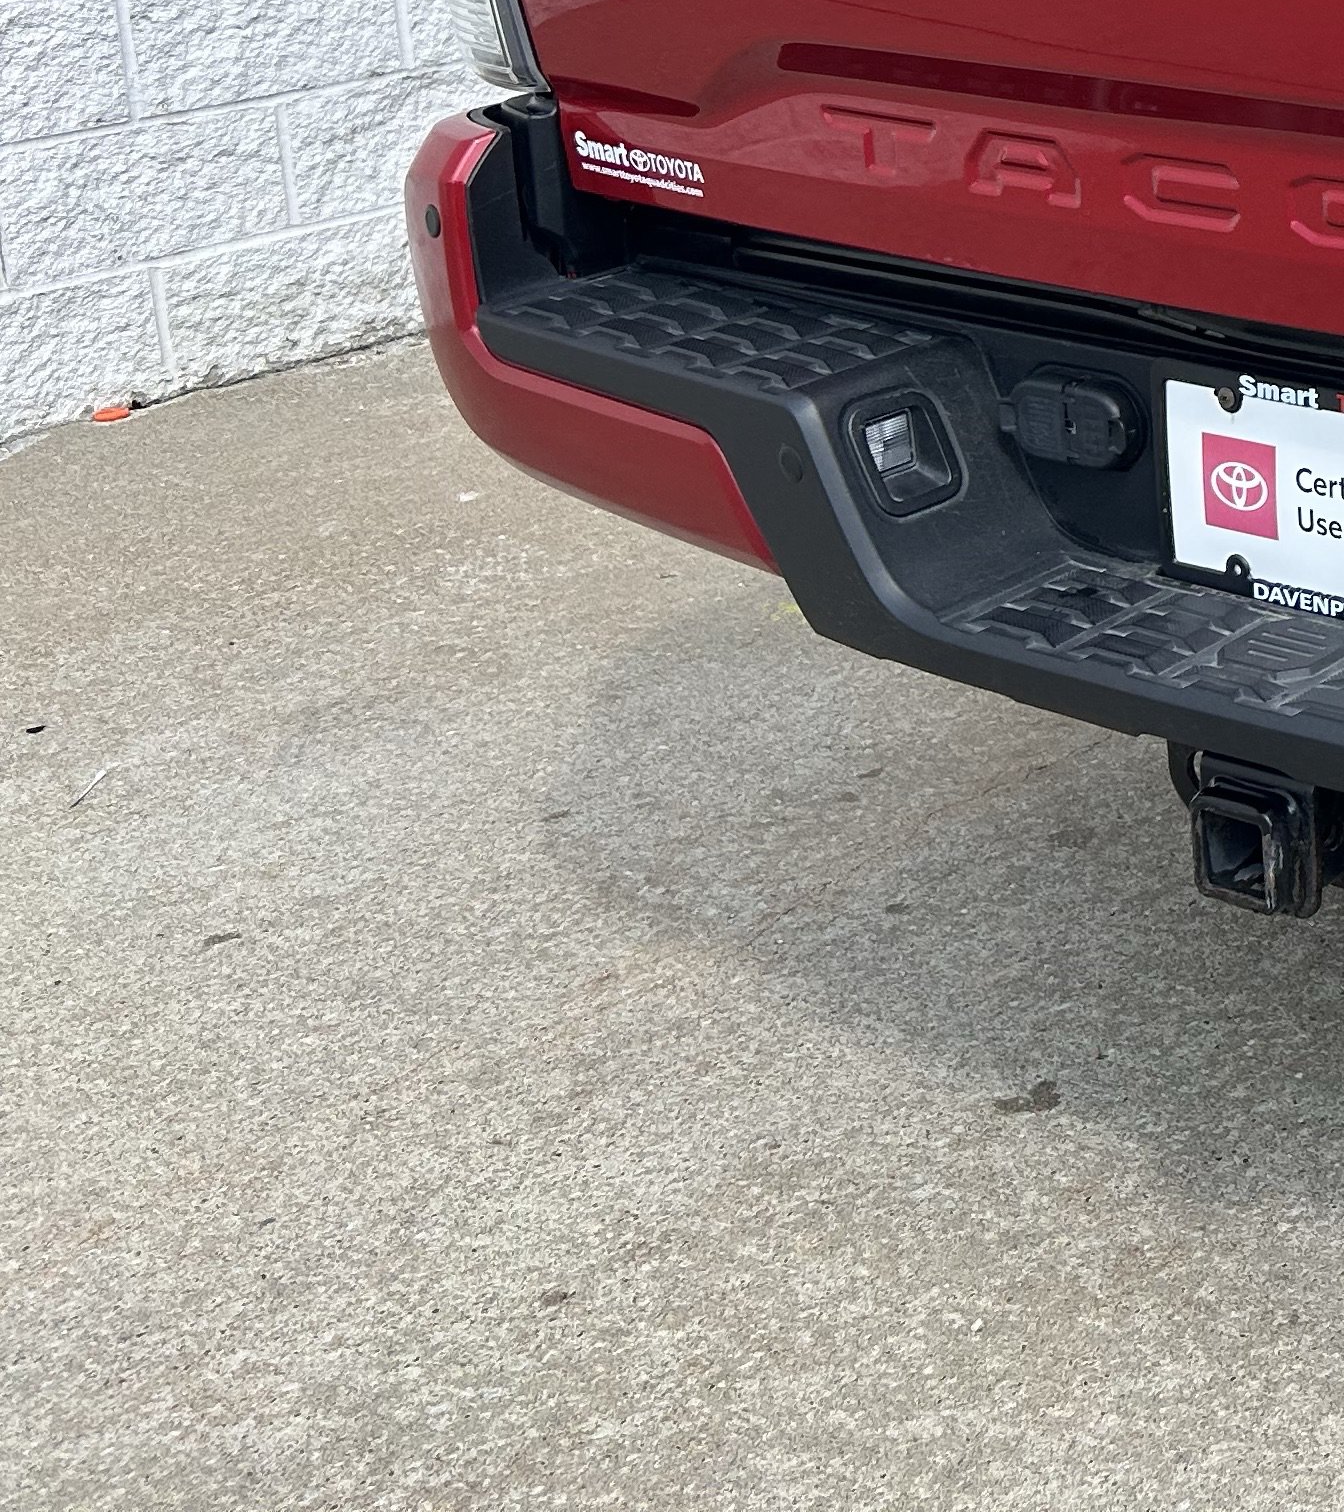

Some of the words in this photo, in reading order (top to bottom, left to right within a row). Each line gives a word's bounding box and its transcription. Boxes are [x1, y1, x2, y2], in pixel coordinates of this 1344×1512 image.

[574, 131, 630, 167] Smart
[648, 153, 705, 184] TOYOTA
[1238, 374, 1319, 410] Smart
